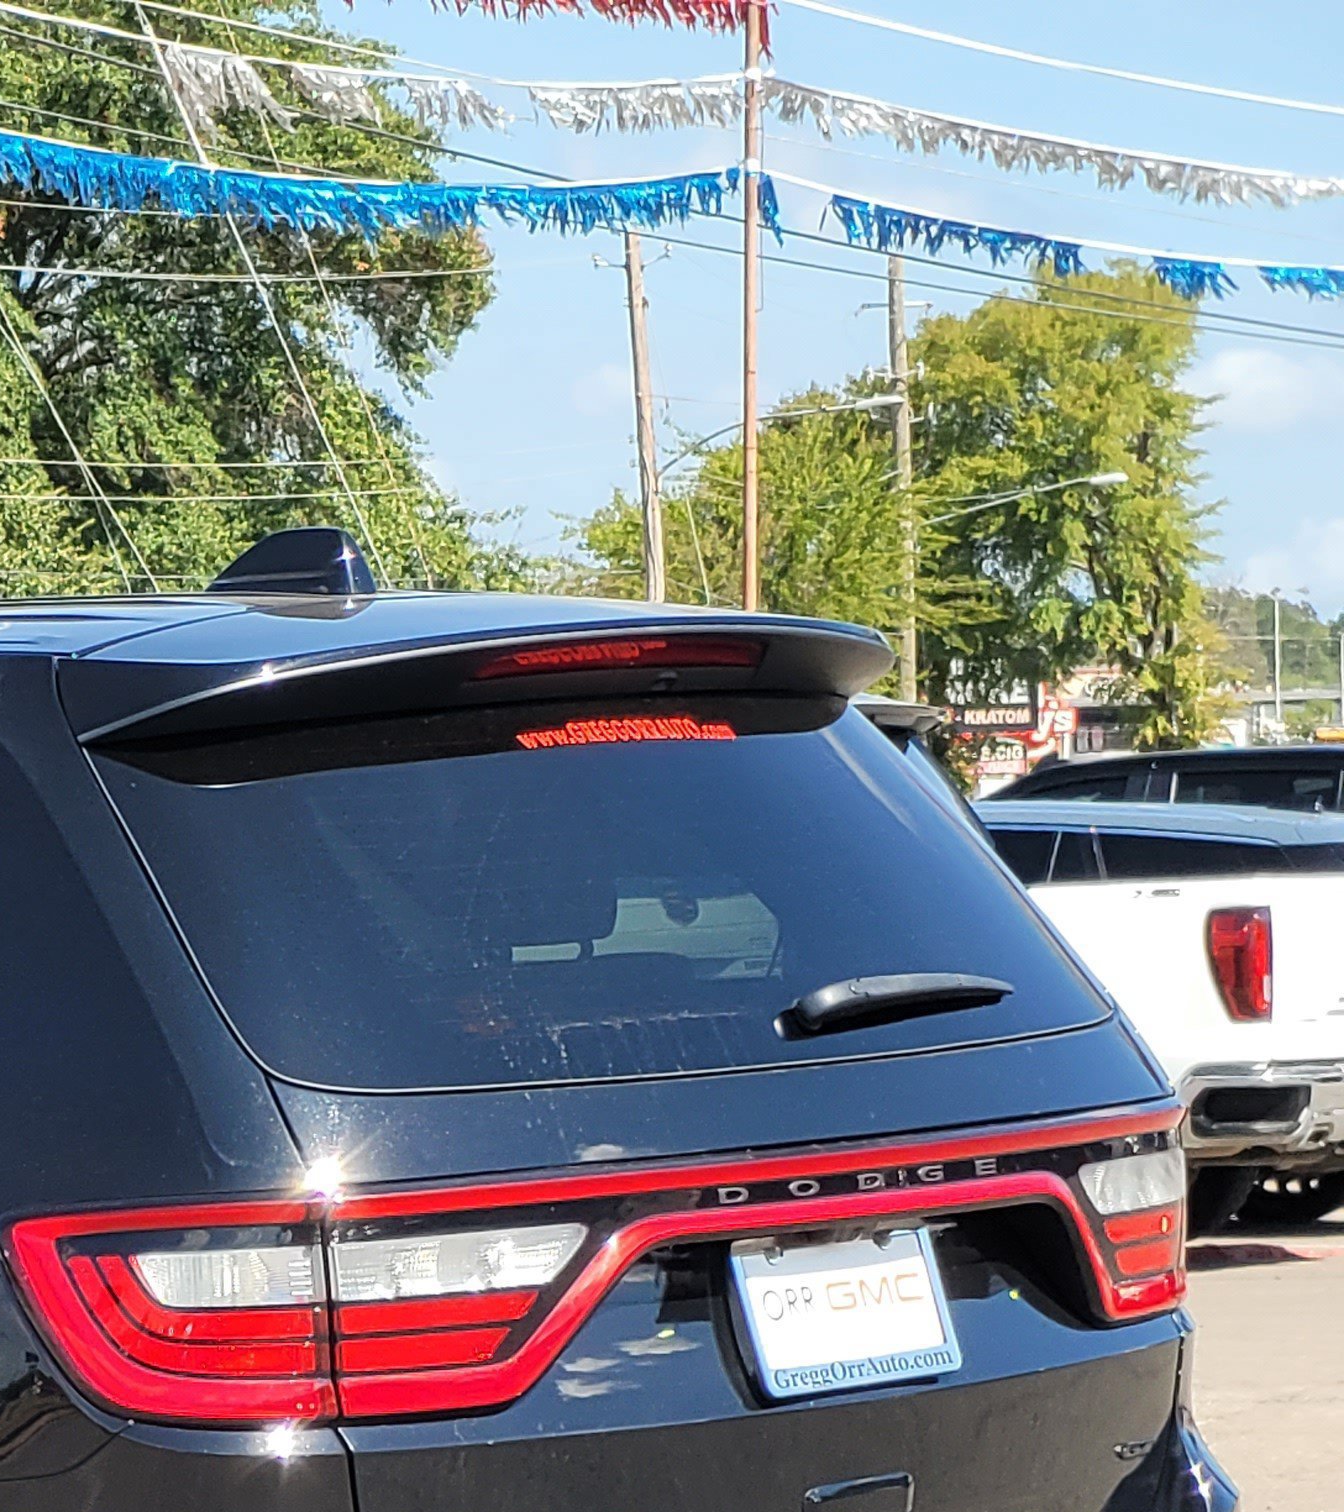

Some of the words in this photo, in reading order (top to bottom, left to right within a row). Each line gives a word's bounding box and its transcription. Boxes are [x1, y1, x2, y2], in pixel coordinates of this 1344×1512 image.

[964, 708, 1030, 725] KRATOM
[717, 1157, 999, 1204] DODGE
[763, 1286, 814, 1321] ORR
[825, 1272, 925, 1311] GMC
[773, 1350, 954, 1389] GreggOrrAuto.com
